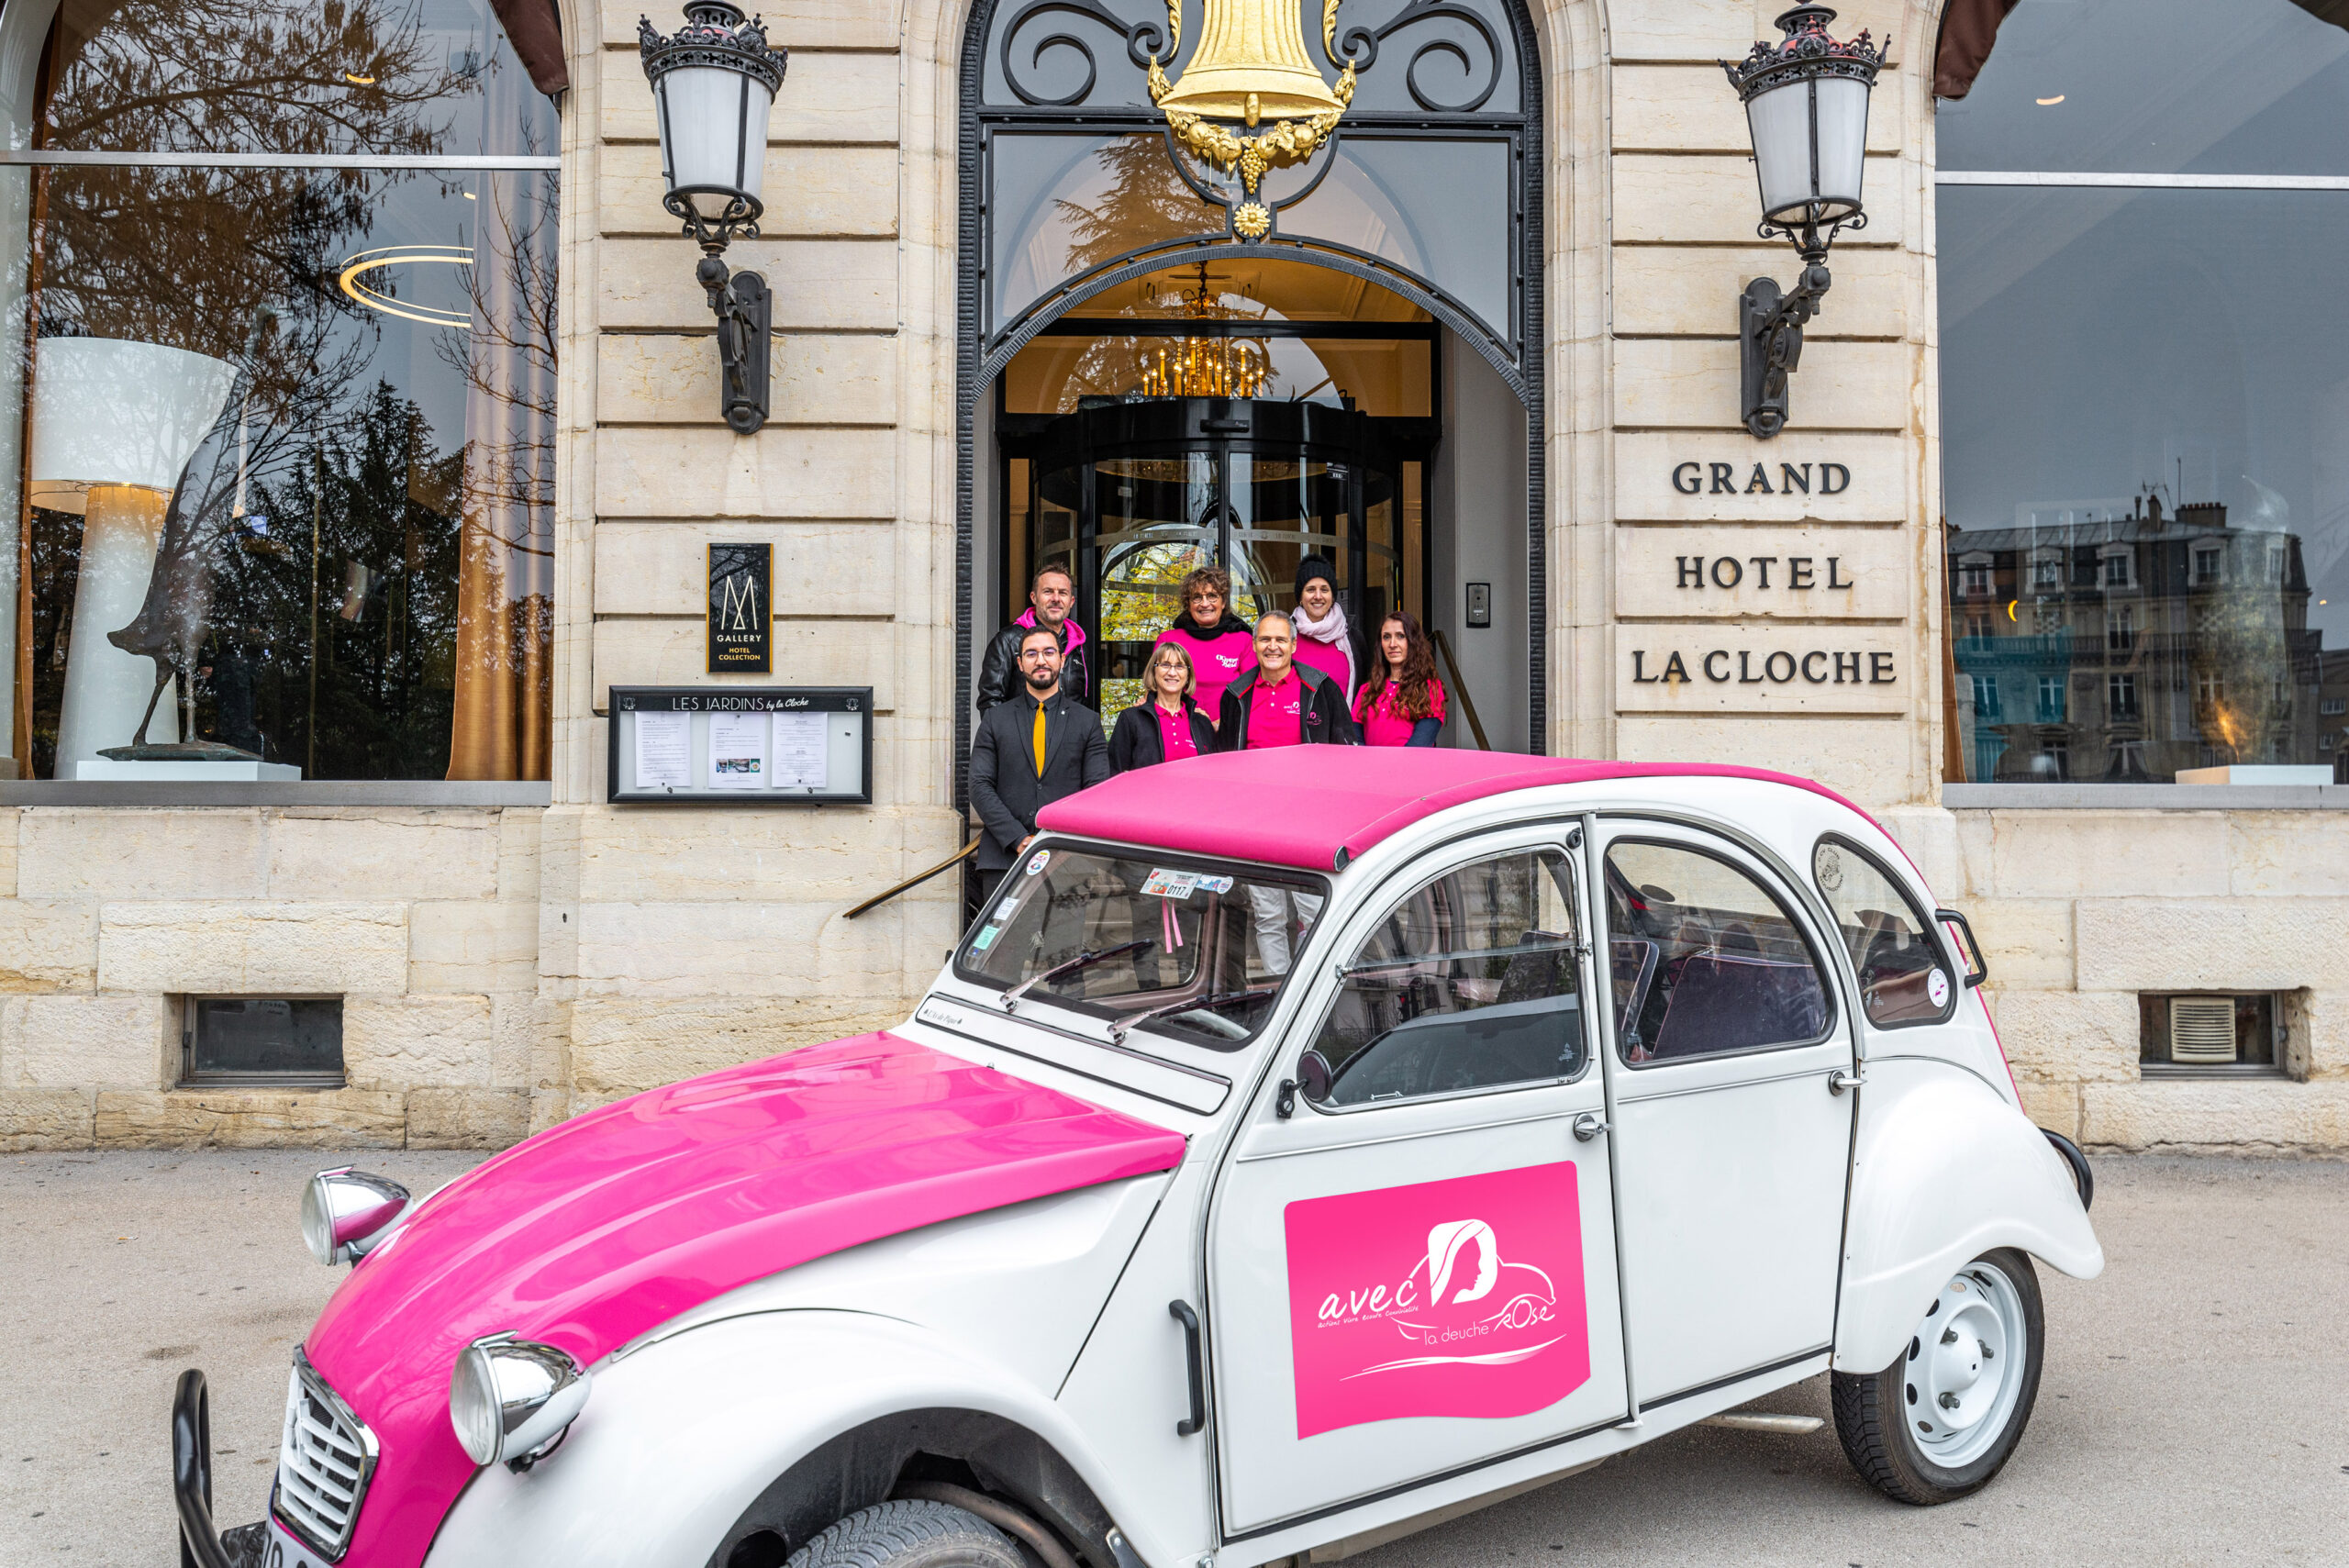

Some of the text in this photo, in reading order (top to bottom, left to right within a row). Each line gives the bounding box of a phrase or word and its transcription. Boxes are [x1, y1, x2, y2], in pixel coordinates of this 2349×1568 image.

[1672, 462, 1851, 495] GRAND
[1675, 556, 1854, 589] HOTEL
[717, 634, 762, 642] GALLERY
[1632, 650, 1898, 684] LA CLOCHE
[673, 696, 809, 711] LES JARDINS by la Cloche
[1166, 884, 1187, 896] 0117
[1318, 1279, 1419, 1320] avec
[1342, 1316, 1359, 1324] Vivre
[1424, 1329, 1439, 1346] la
[1441, 1320, 1490, 1342] deuche
